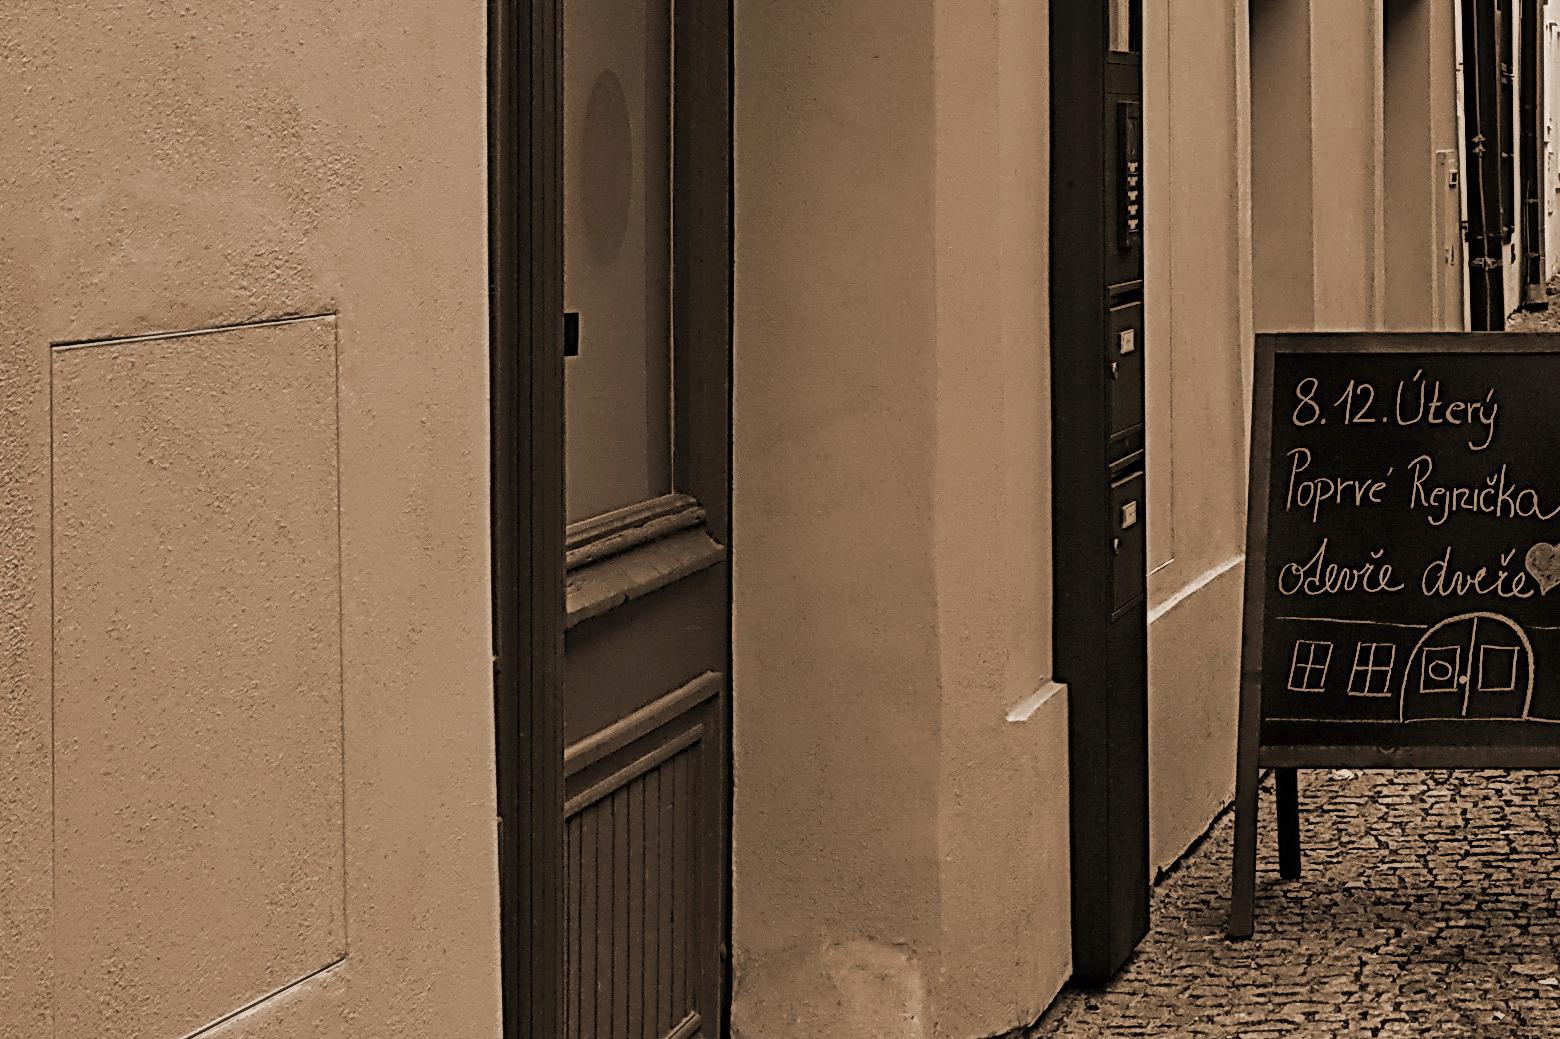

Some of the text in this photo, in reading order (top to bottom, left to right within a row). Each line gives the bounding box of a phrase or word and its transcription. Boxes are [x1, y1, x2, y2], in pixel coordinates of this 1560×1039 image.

[1396, 368, 1498, 451] Úterý
[1286, 447, 1393, 523] Poprvé
[1421, 546, 1535, 598] dveře
